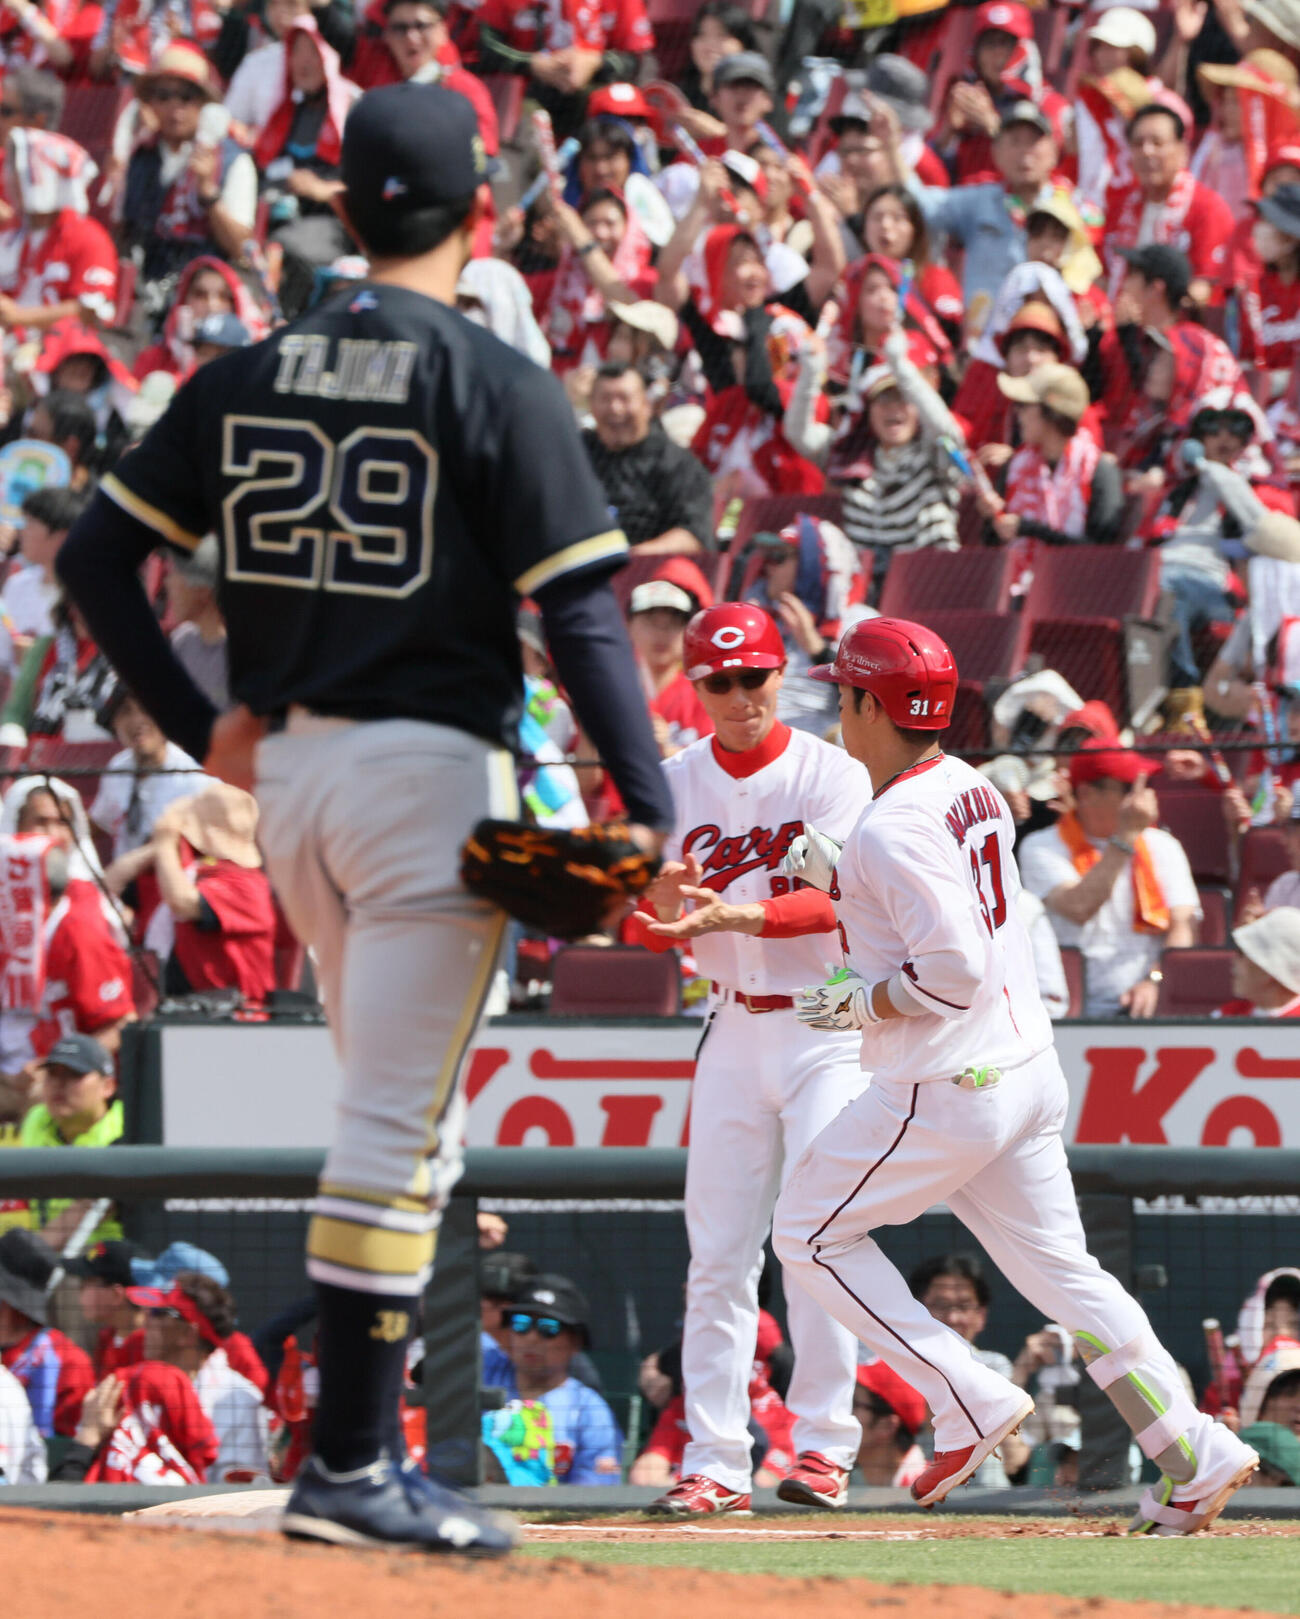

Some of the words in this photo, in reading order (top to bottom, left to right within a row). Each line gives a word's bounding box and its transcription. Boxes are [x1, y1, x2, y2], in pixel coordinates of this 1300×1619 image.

[274, 335, 418, 404] TAJIMA
[222, 414, 439, 599] 29
[710, 626, 746, 650] C
[909, 699, 929, 716] 31
[682, 820, 805, 893] Carp
